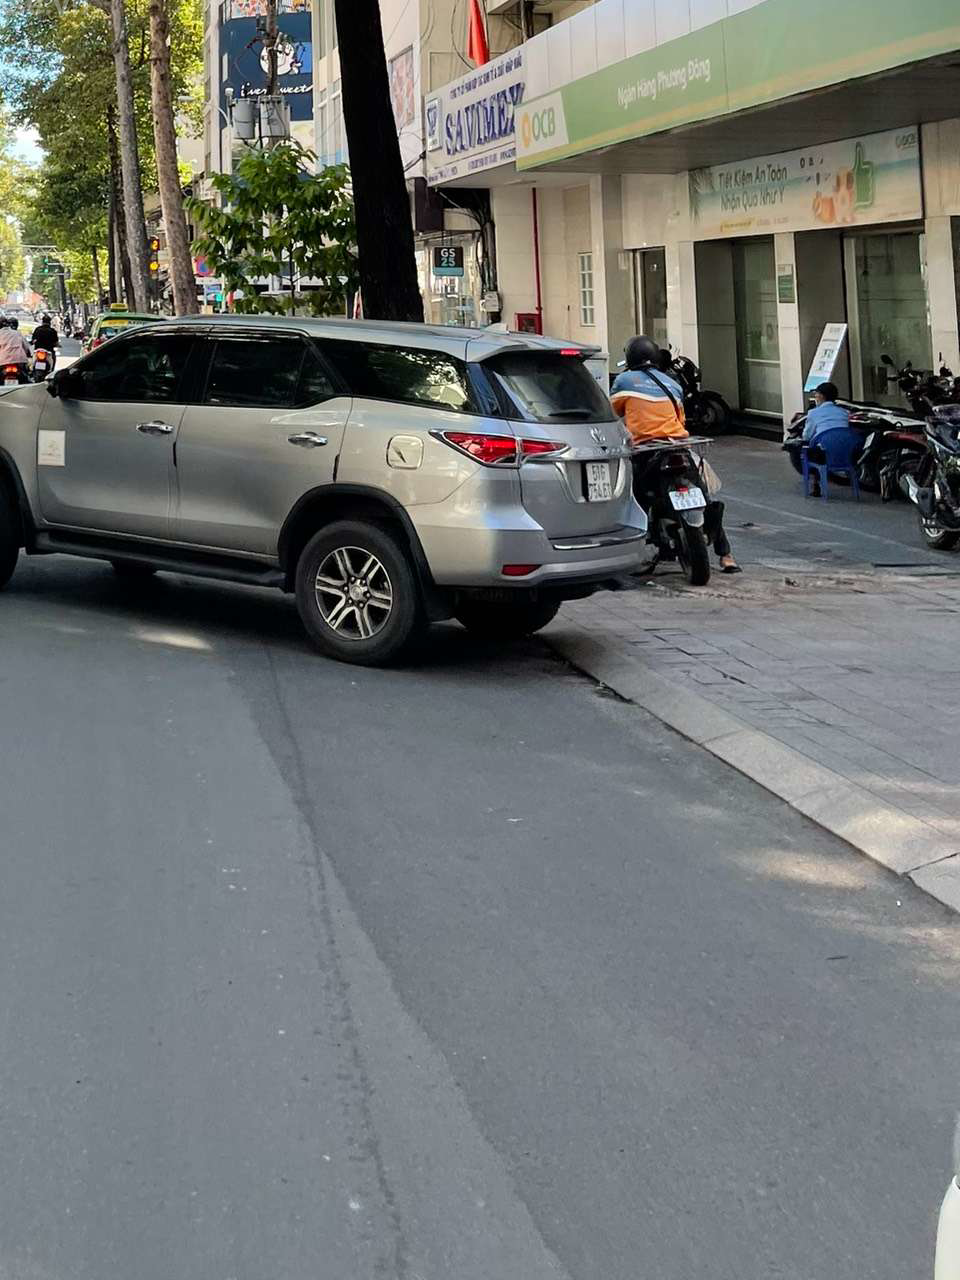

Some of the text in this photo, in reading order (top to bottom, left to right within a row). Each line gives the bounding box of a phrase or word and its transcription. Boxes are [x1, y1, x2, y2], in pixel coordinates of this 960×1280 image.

[617, 56, 711, 109] Ngân Hàng Phương Đông
[532, 107, 556, 142] OCB
[734, 169, 753, 188] Kiệm
[755, 165, 766, 183] An
[767, 163, 787, 181] Toàn
[440, 248, 456, 258] GS
[440, 257, 456, 267] 25
